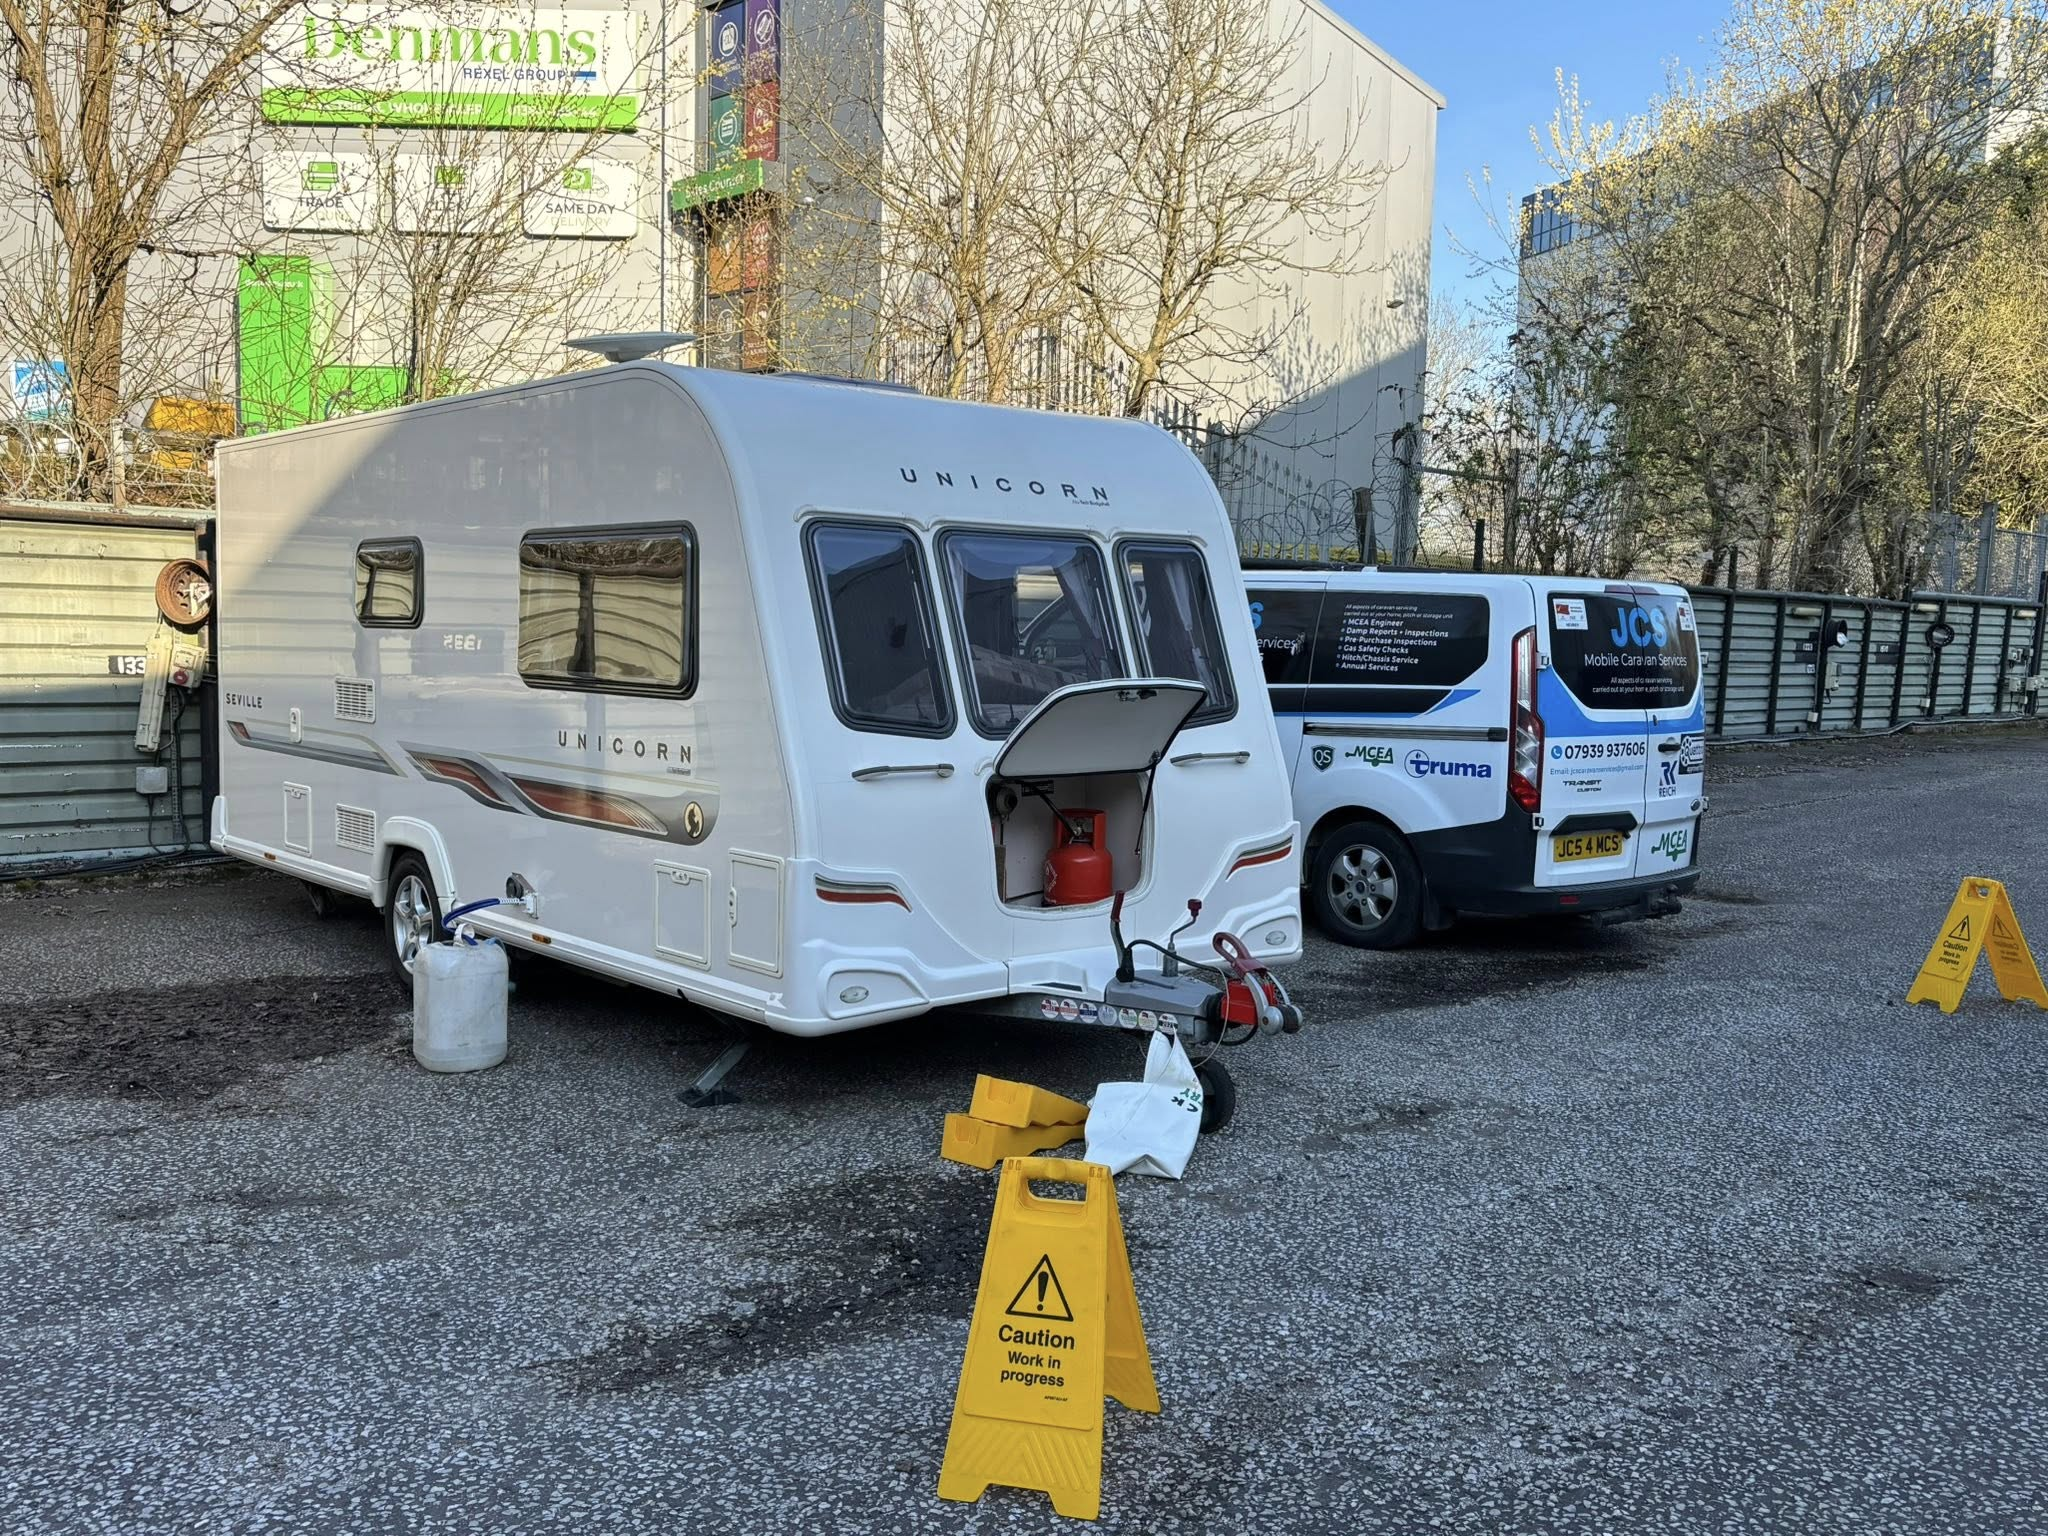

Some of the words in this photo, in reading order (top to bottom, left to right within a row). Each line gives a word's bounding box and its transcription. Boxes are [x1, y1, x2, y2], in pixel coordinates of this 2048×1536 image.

[303, 15, 597, 65] Denmans
[463, 67, 510, 80] REXEL
[514, 69, 566, 81] GROUP
[299, 197, 343, 208] TRADE
[545, 203, 585, 214] SAME
[587, 203, 616, 214] DAY
[900, 468, 1108, 500] UNICORN
[1347, 618, 1369, 626] MCEA
[1370, 618, 1404, 628] Engineer
[1611, 607, 1667, 648] JCS
[1346, 627, 1368, 636] Damp
[1369, 628, 1398, 636] Reports
[1405, 629, 1449, 637] Inspections
[1344, 635, 1392, 644] Pre-Purchase
[1393, 637, 1438, 646] Inspections
[1343, 644, 1357, 652] Gas
[1358, 645, 1381, 654] Safety
[1382, 646, 1409, 654] Checks
[1341, 653, 1390, 663] Hitch/Chassis
[1391, 656, 1419, 664] Service
[1584, 653, 1620, 667] Mobile
[1620, 653, 1658, 667] Caravan
[1658, 653, 1688, 667] Services
[1341, 662, 1367, 670] Annual
[1368, 663, 1399, 671] Services
[225, 693, 263, 709] SEVILLE
[558, 730, 692, 764] UNICORN
[1354, 745, 1394, 760] MCEA
[1564, 744, 1604, 760] 07939
[1606, 742, 1646, 758] 937606
[1314, 749, 1331, 763] QS
[1409, 758, 1492, 778] truma
[1562, 779, 1602, 787] TRANSIT
[1659, 786, 1677, 798] REICH
[1660, 829, 1688, 850] MCEA
[1943, 940, 1969, 952] Caution
[1938, 956, 1960, 965] progress
[1943, 949, 1955, 958] Work
[998, 1324, 1075, 1350] Caution
[1007, 1350, 1043, 1367] Work
[1047, 1355, 1061, 1369] in
[1000, 1369, 1065, 1387] progress
